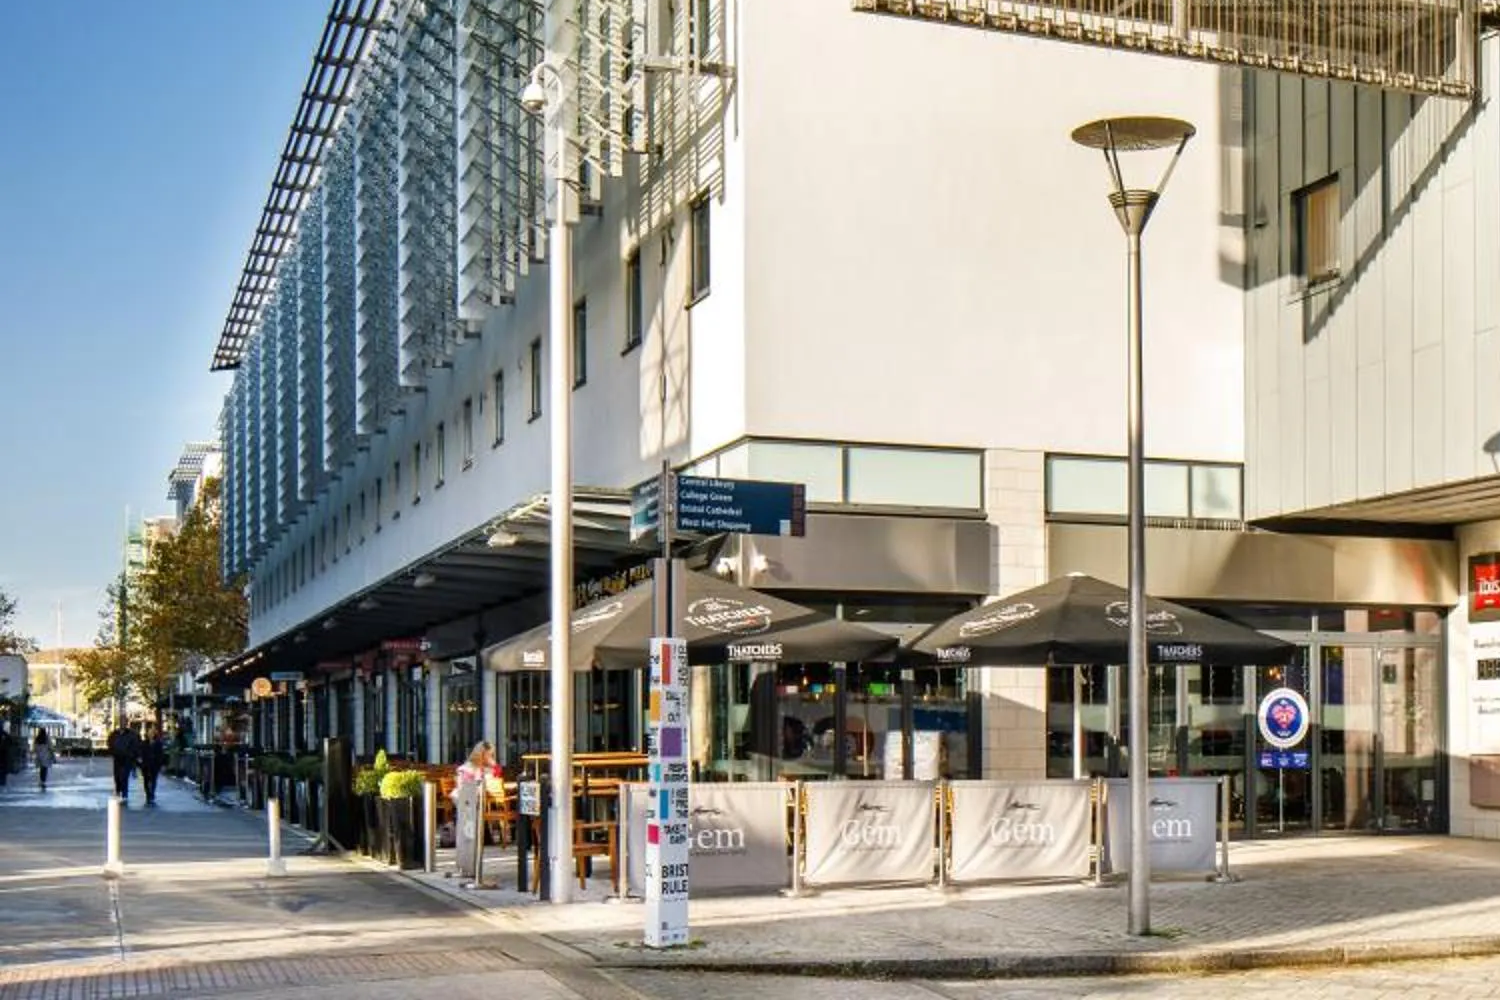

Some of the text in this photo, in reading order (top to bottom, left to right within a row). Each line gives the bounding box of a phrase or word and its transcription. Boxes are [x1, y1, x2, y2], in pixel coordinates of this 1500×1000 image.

[705, 505, 743, 517] Cathedral
[726, 643, 783, 657] THATCHERS
[688, 823, 746, 850] em
[841, 818, 902, 847] Gem
[990, 816, 1055, 844] Gem
[1152, 816, 1193, 839] em
